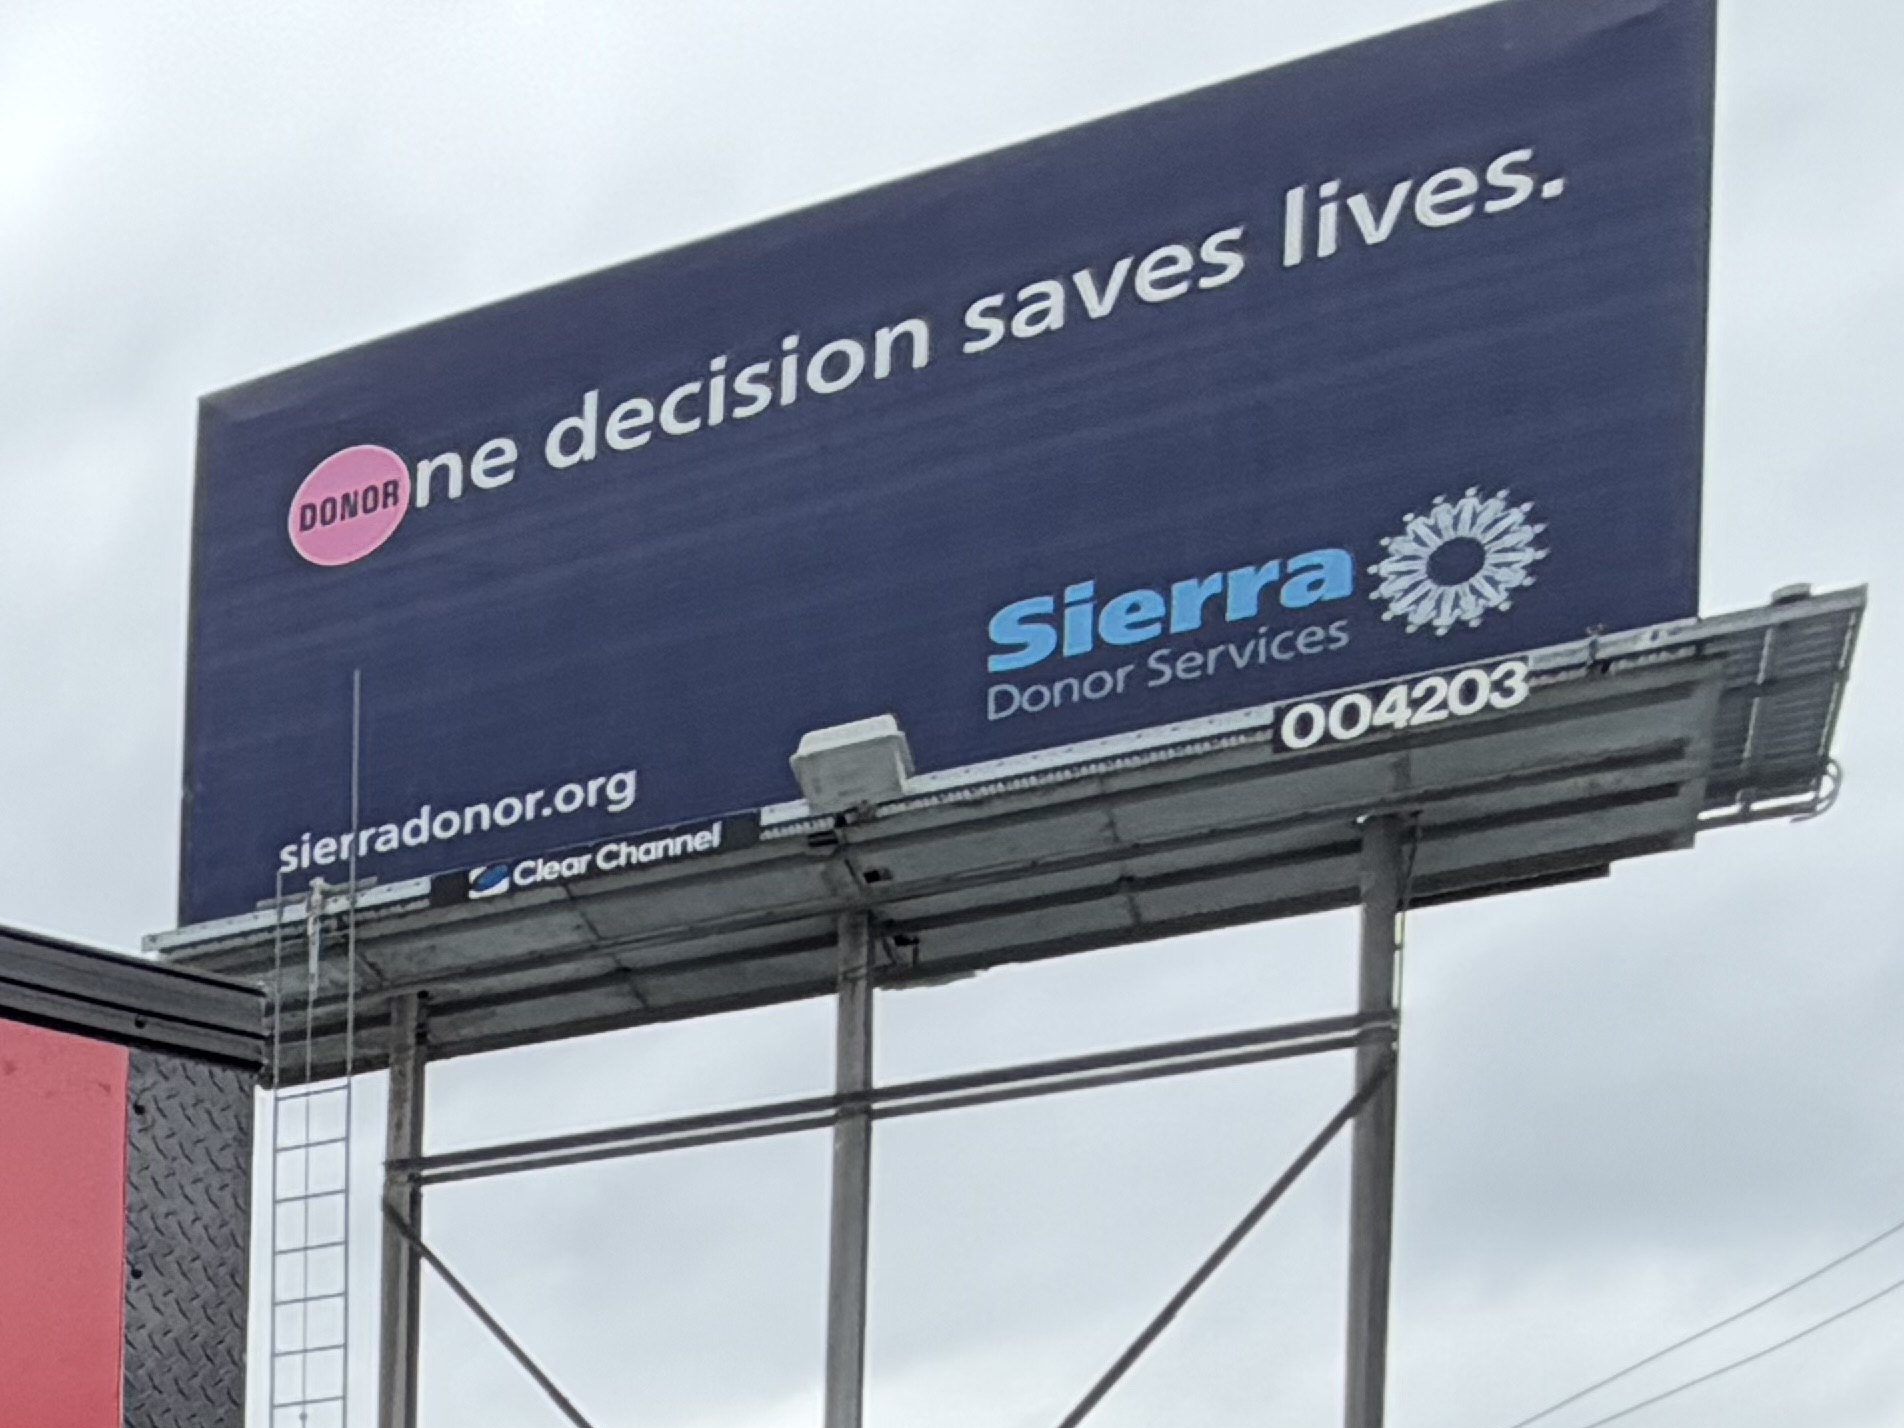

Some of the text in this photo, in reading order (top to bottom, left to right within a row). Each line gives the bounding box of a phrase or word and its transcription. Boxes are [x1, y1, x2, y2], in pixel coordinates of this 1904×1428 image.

[545, 317, 930, 469] decision
[963, 226, 1245, 353] saves
[1283, 148, 1566, 267] lives.
[298, 478, 401, 532] DONOR
[987, 547, 1355, 673] Sierra
[987, 618, 1350, 722] Donor Services
[1280, 659, 1531, 749] 004203
[278, 769, 638, 873] sierradonor.org
[512, 821, 723, 885] Clear Channel
